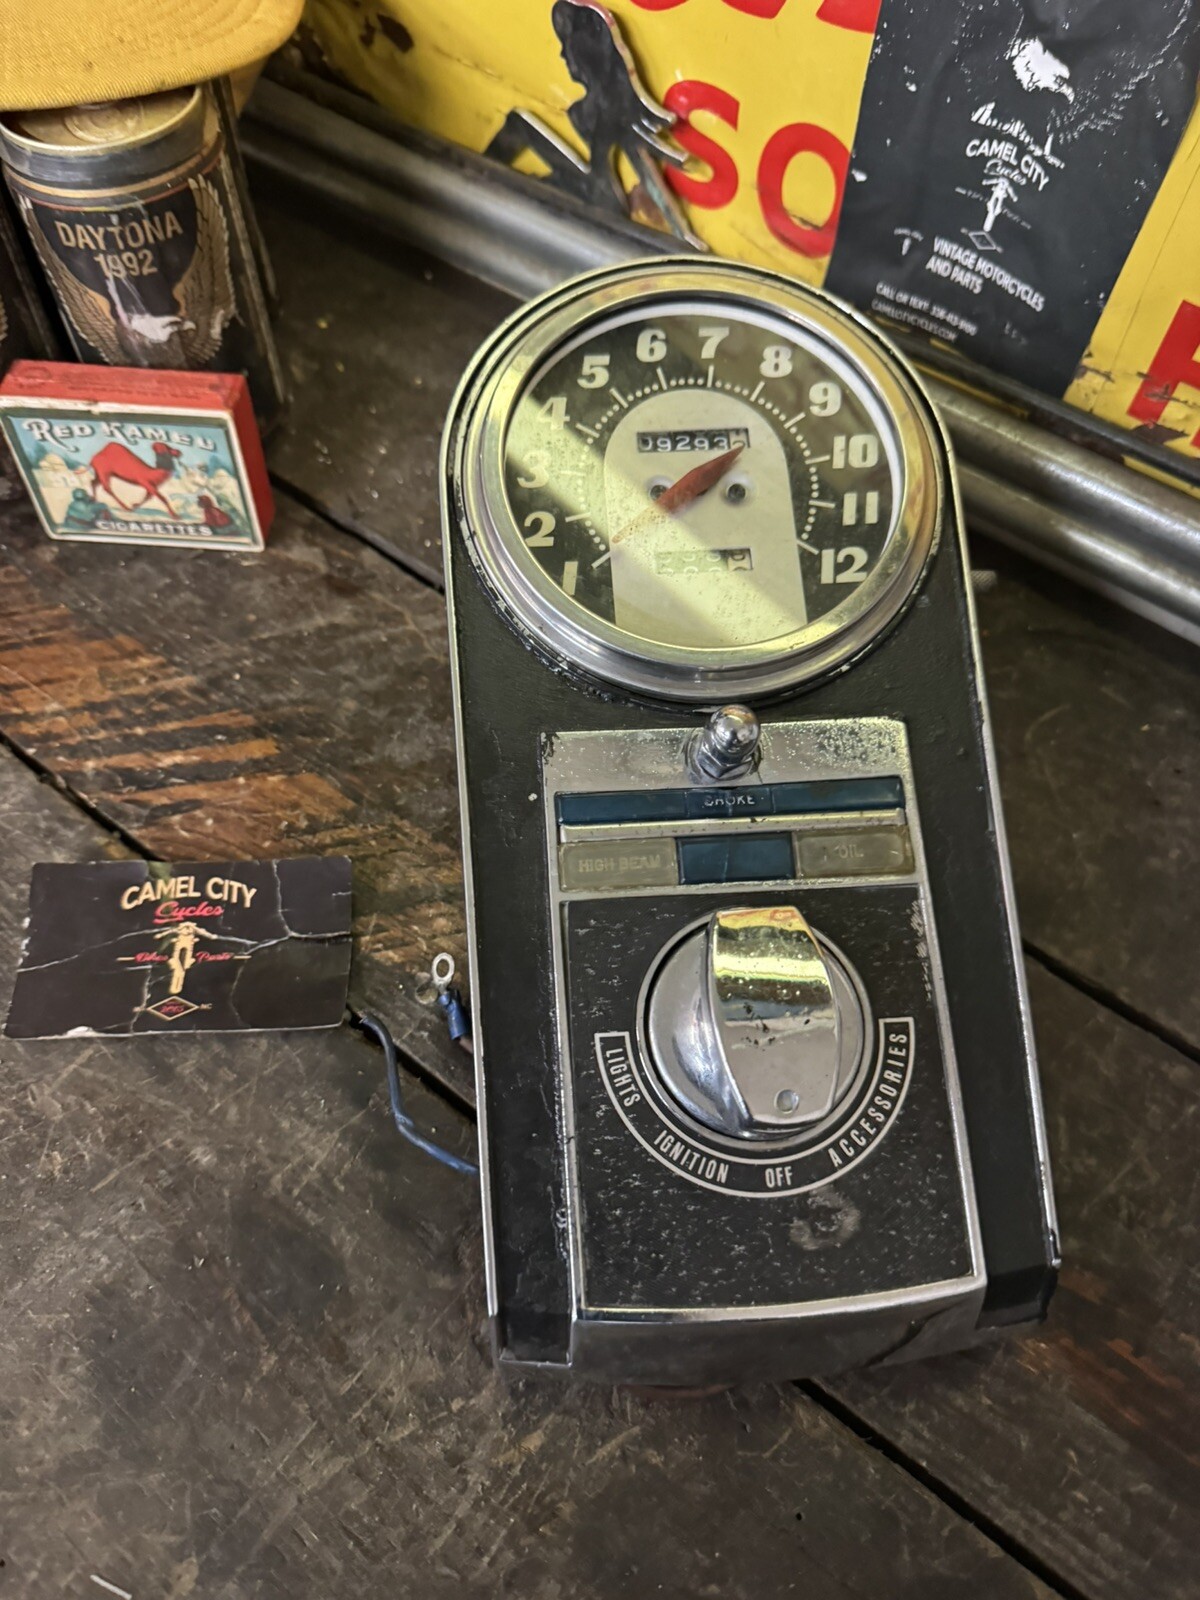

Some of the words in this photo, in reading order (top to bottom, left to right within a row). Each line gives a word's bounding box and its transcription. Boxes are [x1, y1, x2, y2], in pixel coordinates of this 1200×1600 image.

[966, 138, 1018, 166] CAMEL
[1020, 154, 1050, 192] CITY
[983, 158, 1027, 186] Cycles
[54, 210, 183, 250] DAYTONA
[94, 249, 157, 279] 1992
[925, 254, 953, 278] AND
[950, 265, 984, 295] PARTS
[933, 236, 978, 270] VINTAGE
[974, 257, 1046, 312] MOTORCYCLES
[636, 329, 667, 363] 6
[699, 327, 730, 359] 7
[577, 354, 610, 389] 5
[760, 346, 792, 378] 8
[537, 397, 570, 431] 4
[809, 382, 842, 417] 9
[22, 418, 97, 453] RED
[102, 421, 217, 451] KAMEL
[832, 434, 879, 469] 10
[517, 451, 550, 488] 3
[843, 491, 879, 526] 11
[96, 520, 213, 536] CIGARETTES
[524, 511, 556, 547] 2
[562, 561, 578, 596] 1
[821, 546, 868, 584] 12
[578, 857, 615, 872] HIGH
[839, 844, 861, 858] OIL
[120, 876, 201, 910] CAMEL
[206, 876, 257, 908] CITY
[153, 901, 224, 924] Cycles
[605, 1048, 641, 1107] LIGHTS
[654, 1130, 729, 1184] IGNITION
[764, 1166, 794, 1188] OFF
[828, 1032, 908, 1167] ACCESSORIES
